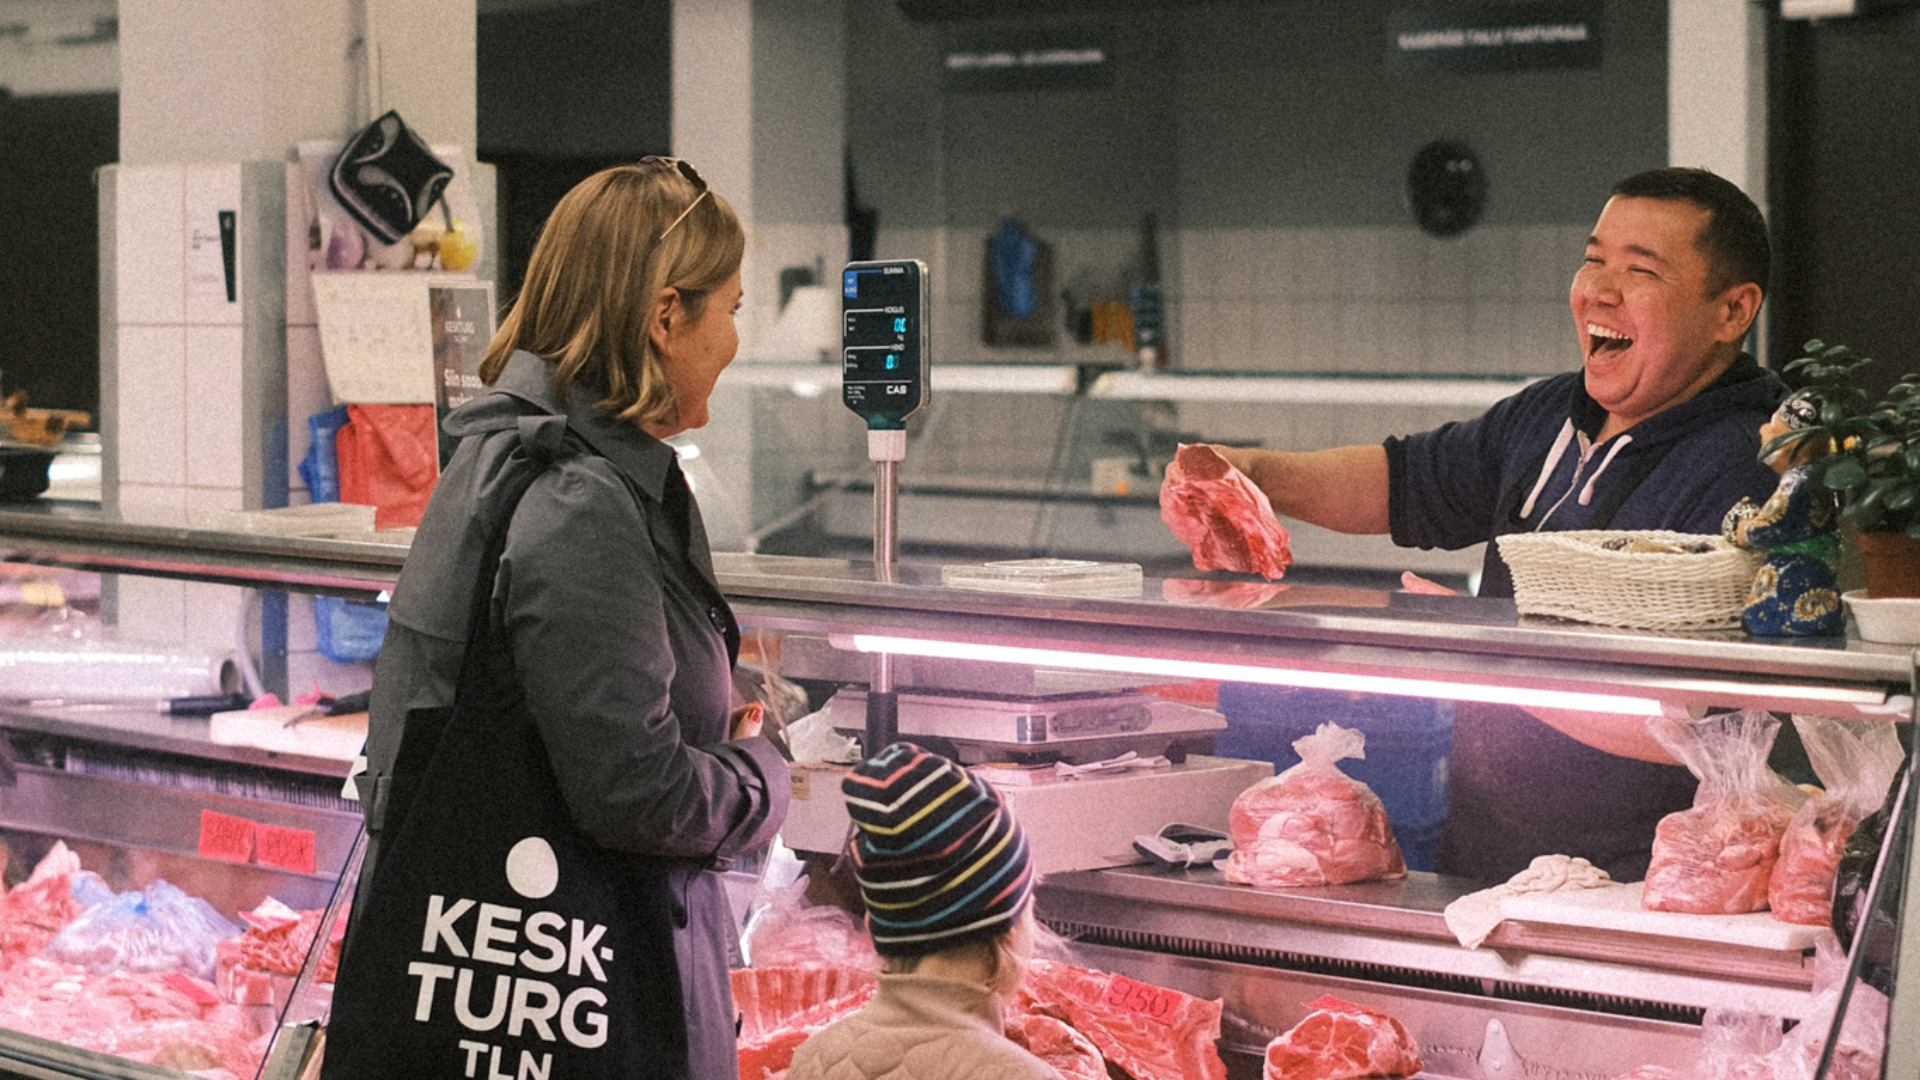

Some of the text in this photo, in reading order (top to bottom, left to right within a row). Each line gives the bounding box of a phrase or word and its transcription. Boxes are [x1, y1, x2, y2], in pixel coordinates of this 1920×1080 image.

[883, 267, 904, 275] SUMMA
[444, 368, 460, 387] Siin
[886, 385, 907, 395] CAS
[421, 894, 614, 983] KESK-
[407, 961, 609, 1049] TURG
[1108, 979, 1169, 1017] 950
[458, 1039, 553, 1080] TLN
